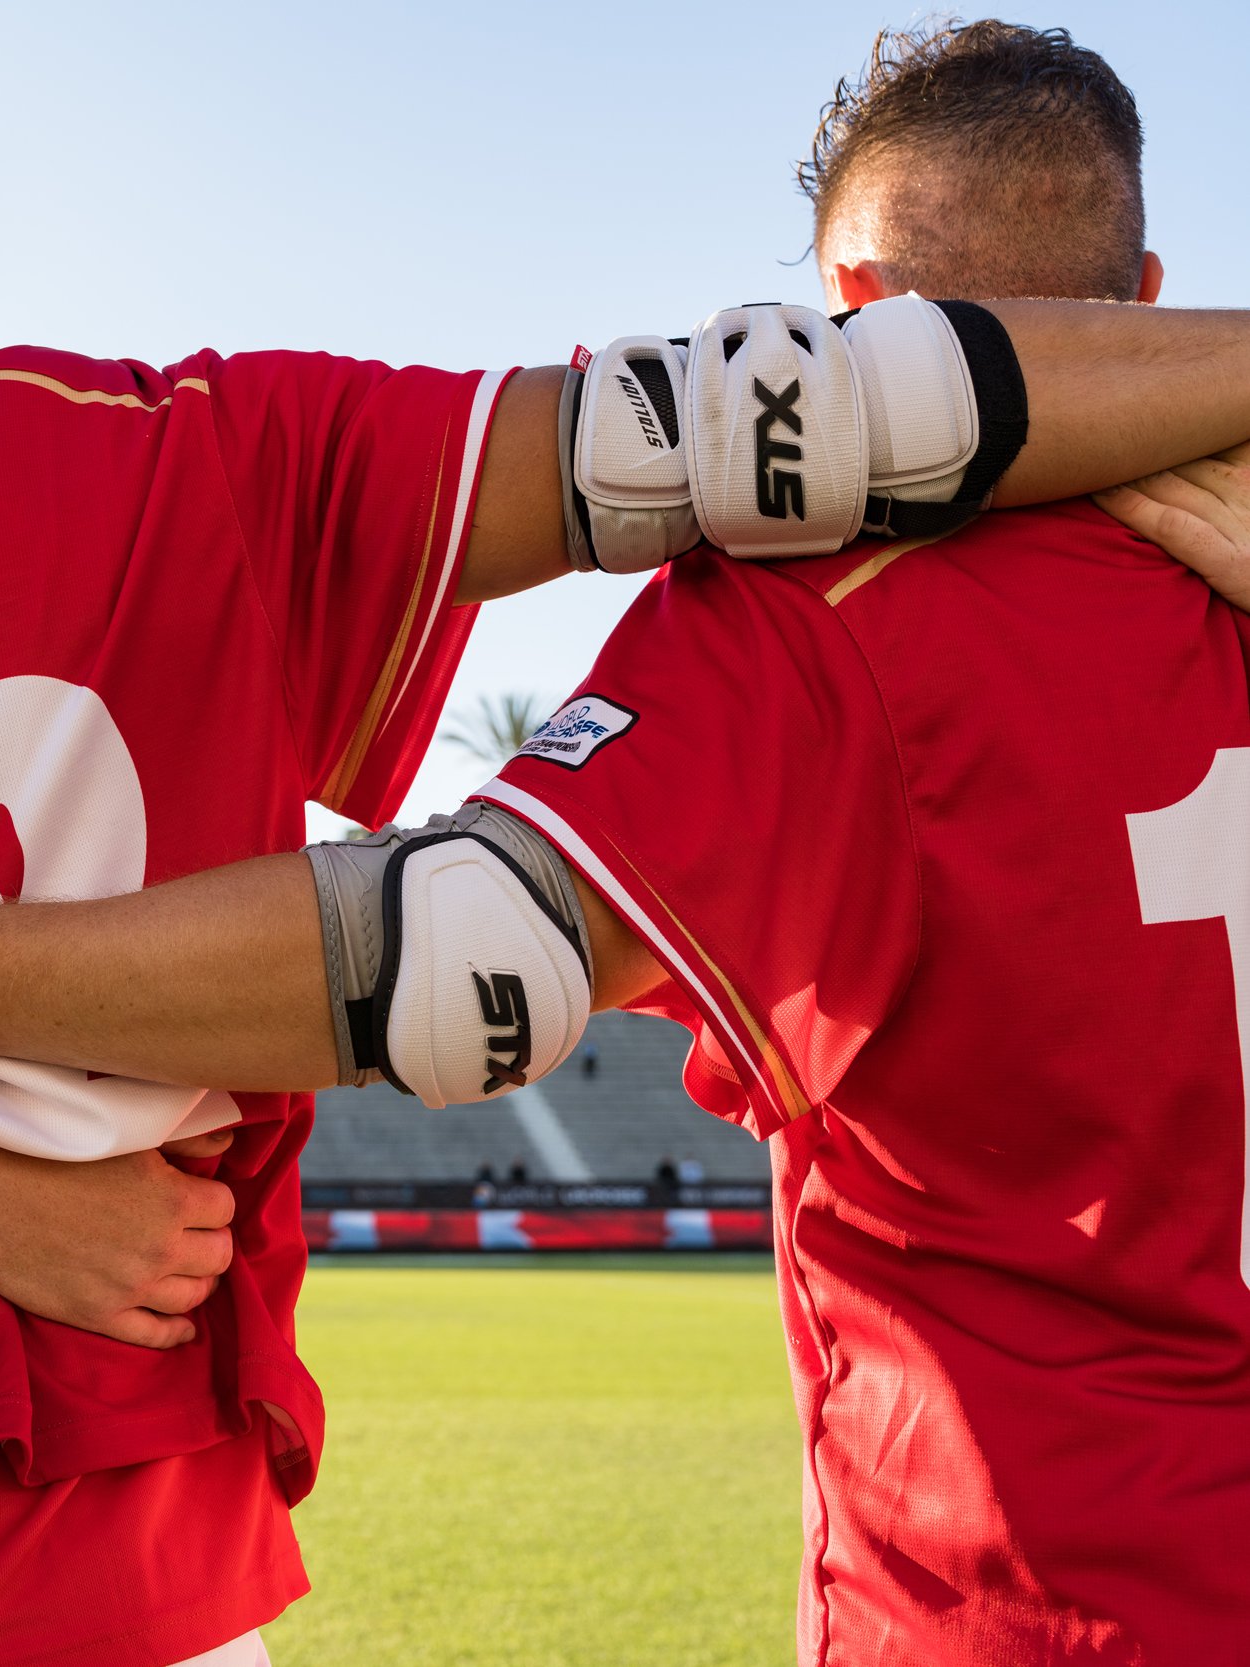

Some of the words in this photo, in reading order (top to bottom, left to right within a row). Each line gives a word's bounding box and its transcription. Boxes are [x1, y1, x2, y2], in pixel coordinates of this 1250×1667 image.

[576, 346, 592, 370] STX
[615, 374, 664, 449] STALLION
[752, 374, 807, 522] STX
[468, 961, 532, 1095] STX
